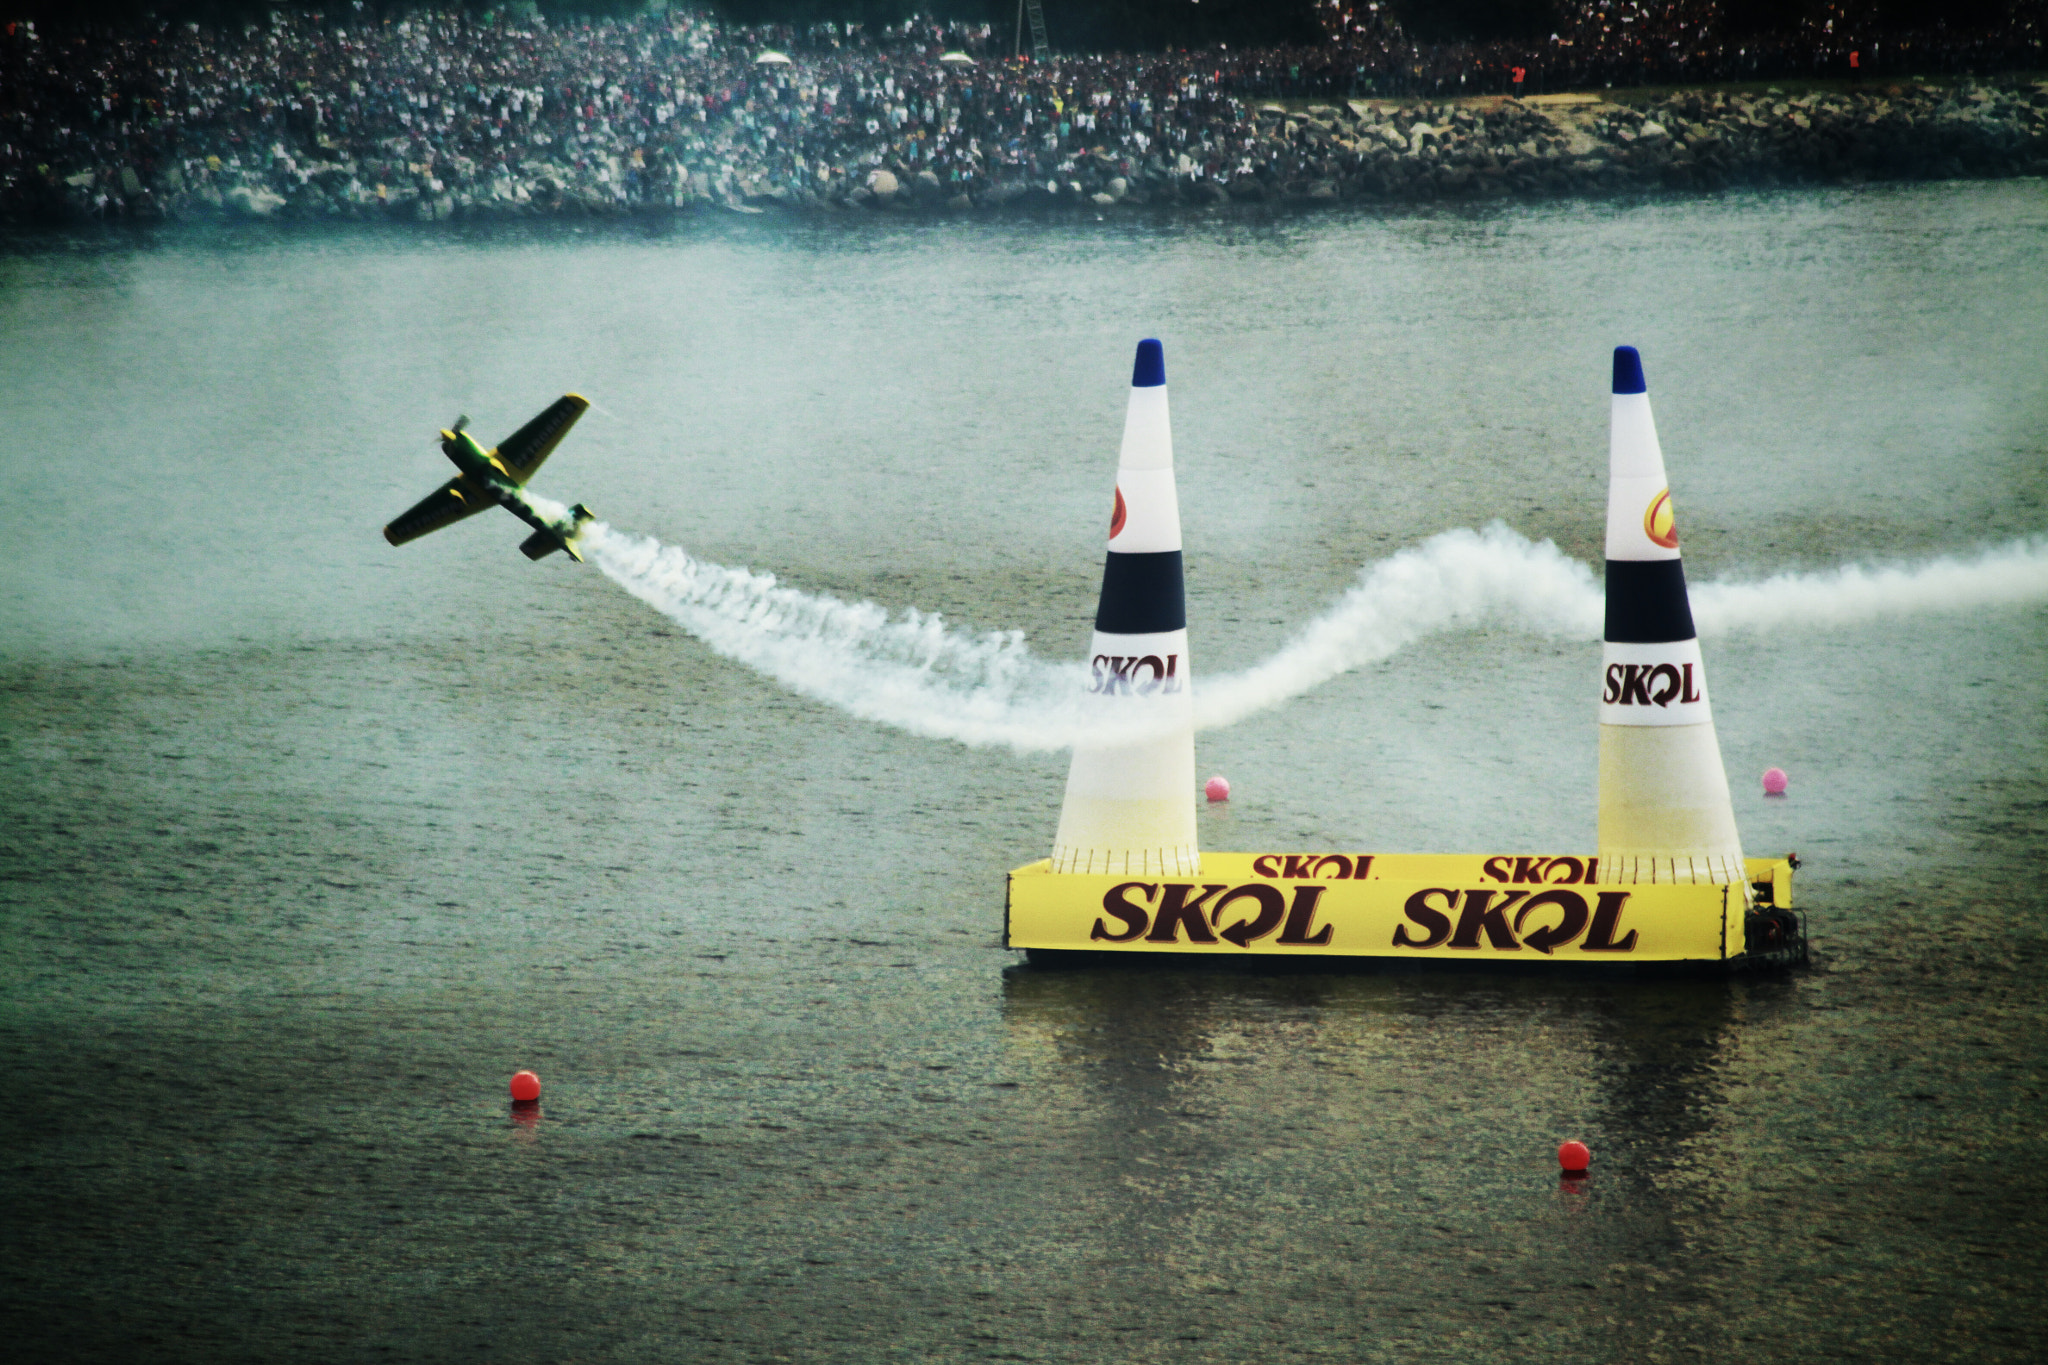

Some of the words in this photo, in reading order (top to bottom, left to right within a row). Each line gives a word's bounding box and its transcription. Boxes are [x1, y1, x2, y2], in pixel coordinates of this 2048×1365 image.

[1088, 654, 1182, 697] SKOL
[1603, 663, 1700, 708] SKOL
[1090, 882, 1334, 948] SKOL
[1392, 888, 1639, 955] SKOL
